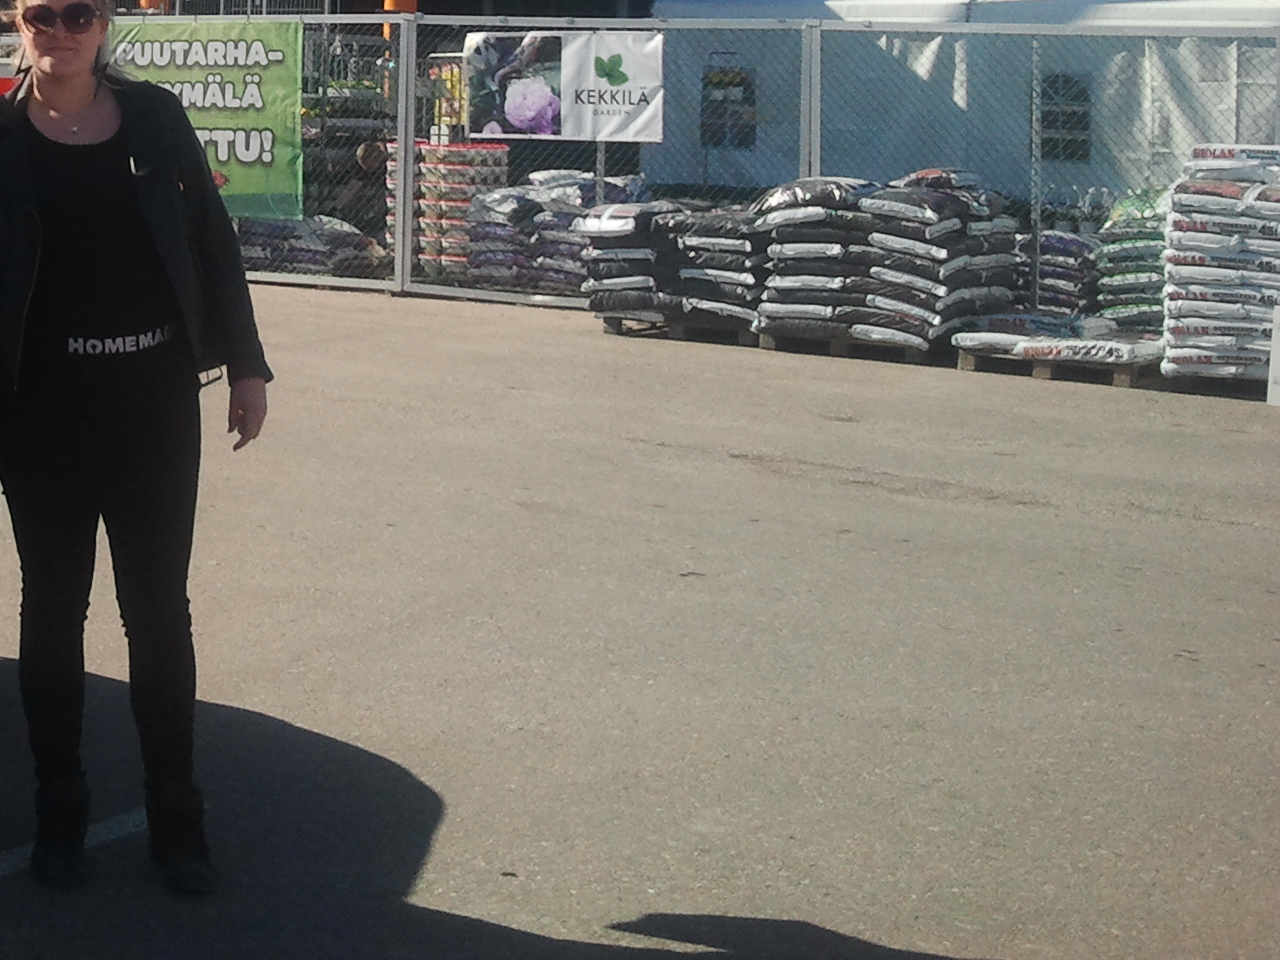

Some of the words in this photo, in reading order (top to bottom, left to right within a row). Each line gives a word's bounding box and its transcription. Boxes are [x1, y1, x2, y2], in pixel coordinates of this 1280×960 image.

[115, 41, 284, 66] PUUTARHA-
[574, 86, 650, 105] KEKKILÄ
[1193, 148, 1235, 158] BIOLAN
[69, 325, 169, 354] HOMEMA
